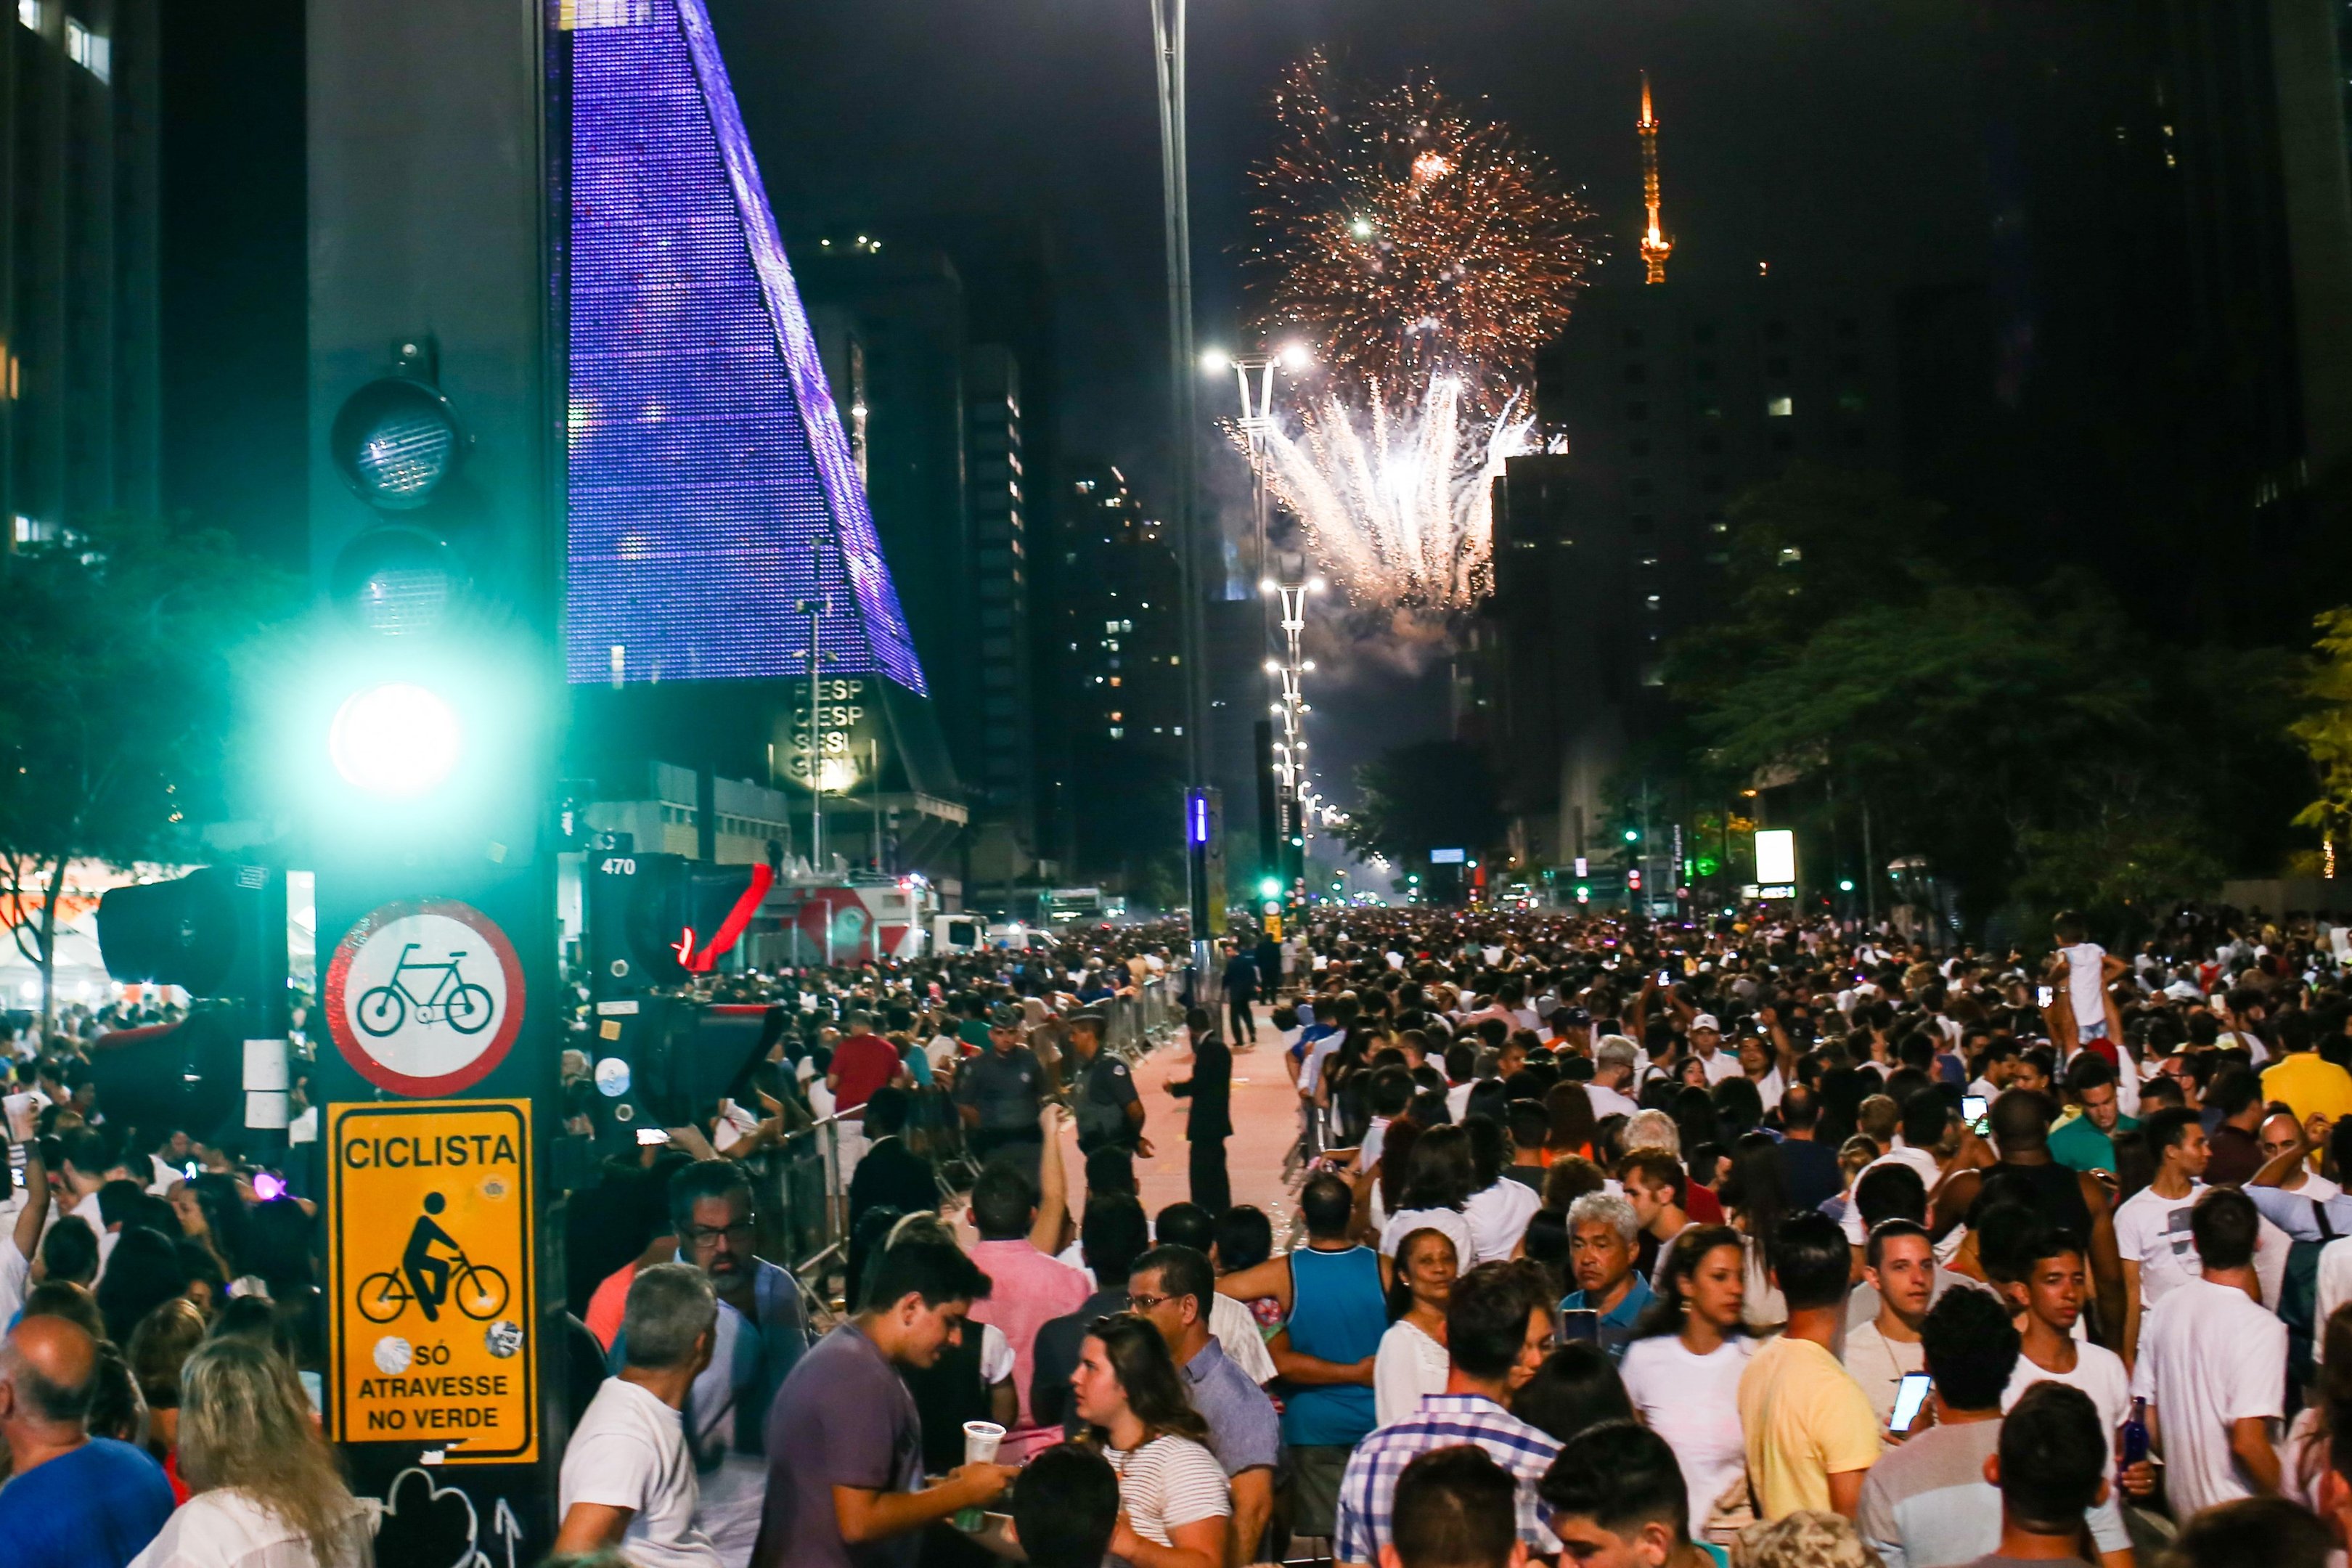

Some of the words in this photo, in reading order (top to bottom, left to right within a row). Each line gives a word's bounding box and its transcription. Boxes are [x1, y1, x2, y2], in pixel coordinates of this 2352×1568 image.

[795, 679, 864, 701] FESP
[794, 706, 865, 727] CESP
[600, 857, 636, 875] 470
[344, 1134, 517, 1169] CICLISTA
[415, 1339, 450, 1365] SÓ
[358, 1376, 507, 1400] ATRAVESSE
[368, 1409, 407, 1430] NO
[413, 1408, 499, 1429] VERDE
